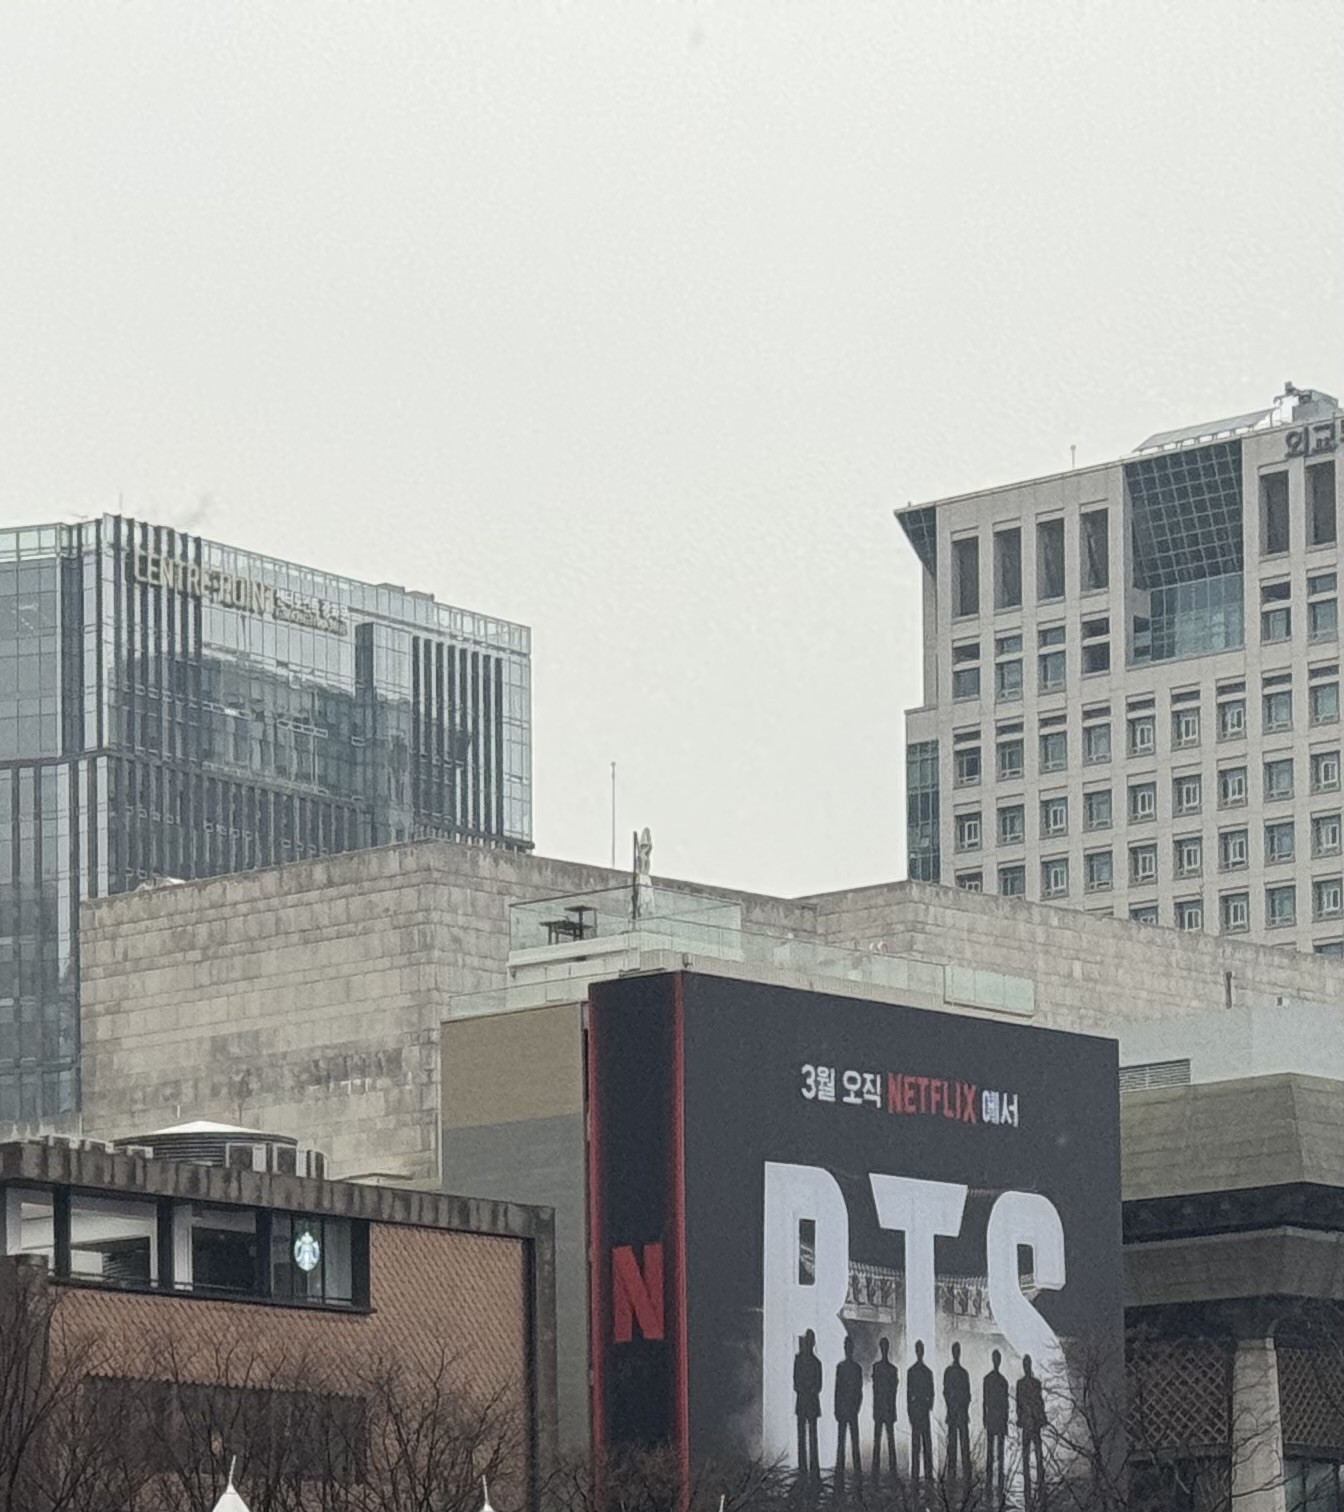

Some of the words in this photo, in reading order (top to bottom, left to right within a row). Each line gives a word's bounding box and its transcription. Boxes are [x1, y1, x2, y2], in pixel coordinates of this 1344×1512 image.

[1284, 420, 1344, 458] 외교
[801, 1064, 836, 1102] 3월
[842, 1070, 881, 1109] 오직
[887, 1072, 977, 1124] NETFLIX
[981, 1089, 1019, 1128] 에서
[612, 1243, 665, 1342] N
[763, 1161, 1072, 1480] BTS
